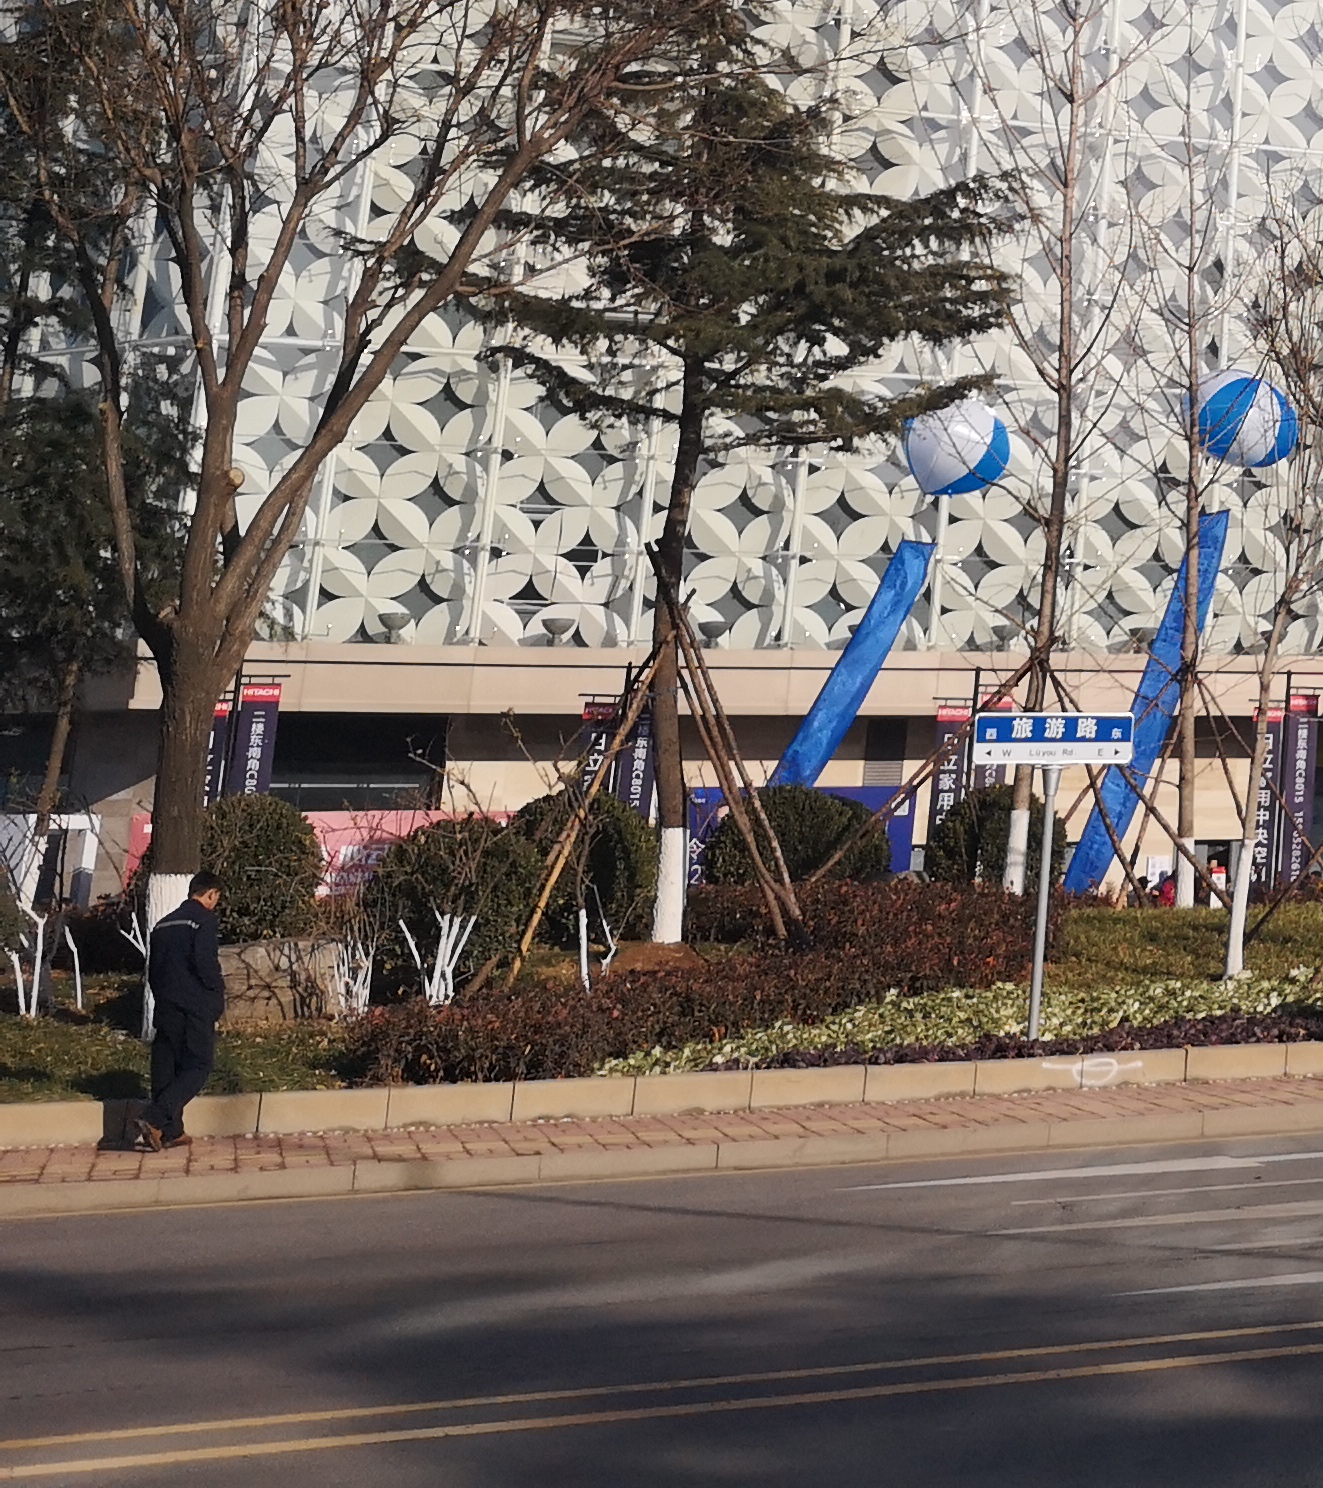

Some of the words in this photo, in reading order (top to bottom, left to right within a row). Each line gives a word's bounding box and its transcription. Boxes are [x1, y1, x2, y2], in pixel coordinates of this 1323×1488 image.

[244, 688, 280, 696] HITACHI
[1011, 717, 1098, 739] 旅游路
[1002, 749, 1012, 757] W
[1097, 749, 1104, 757] E
